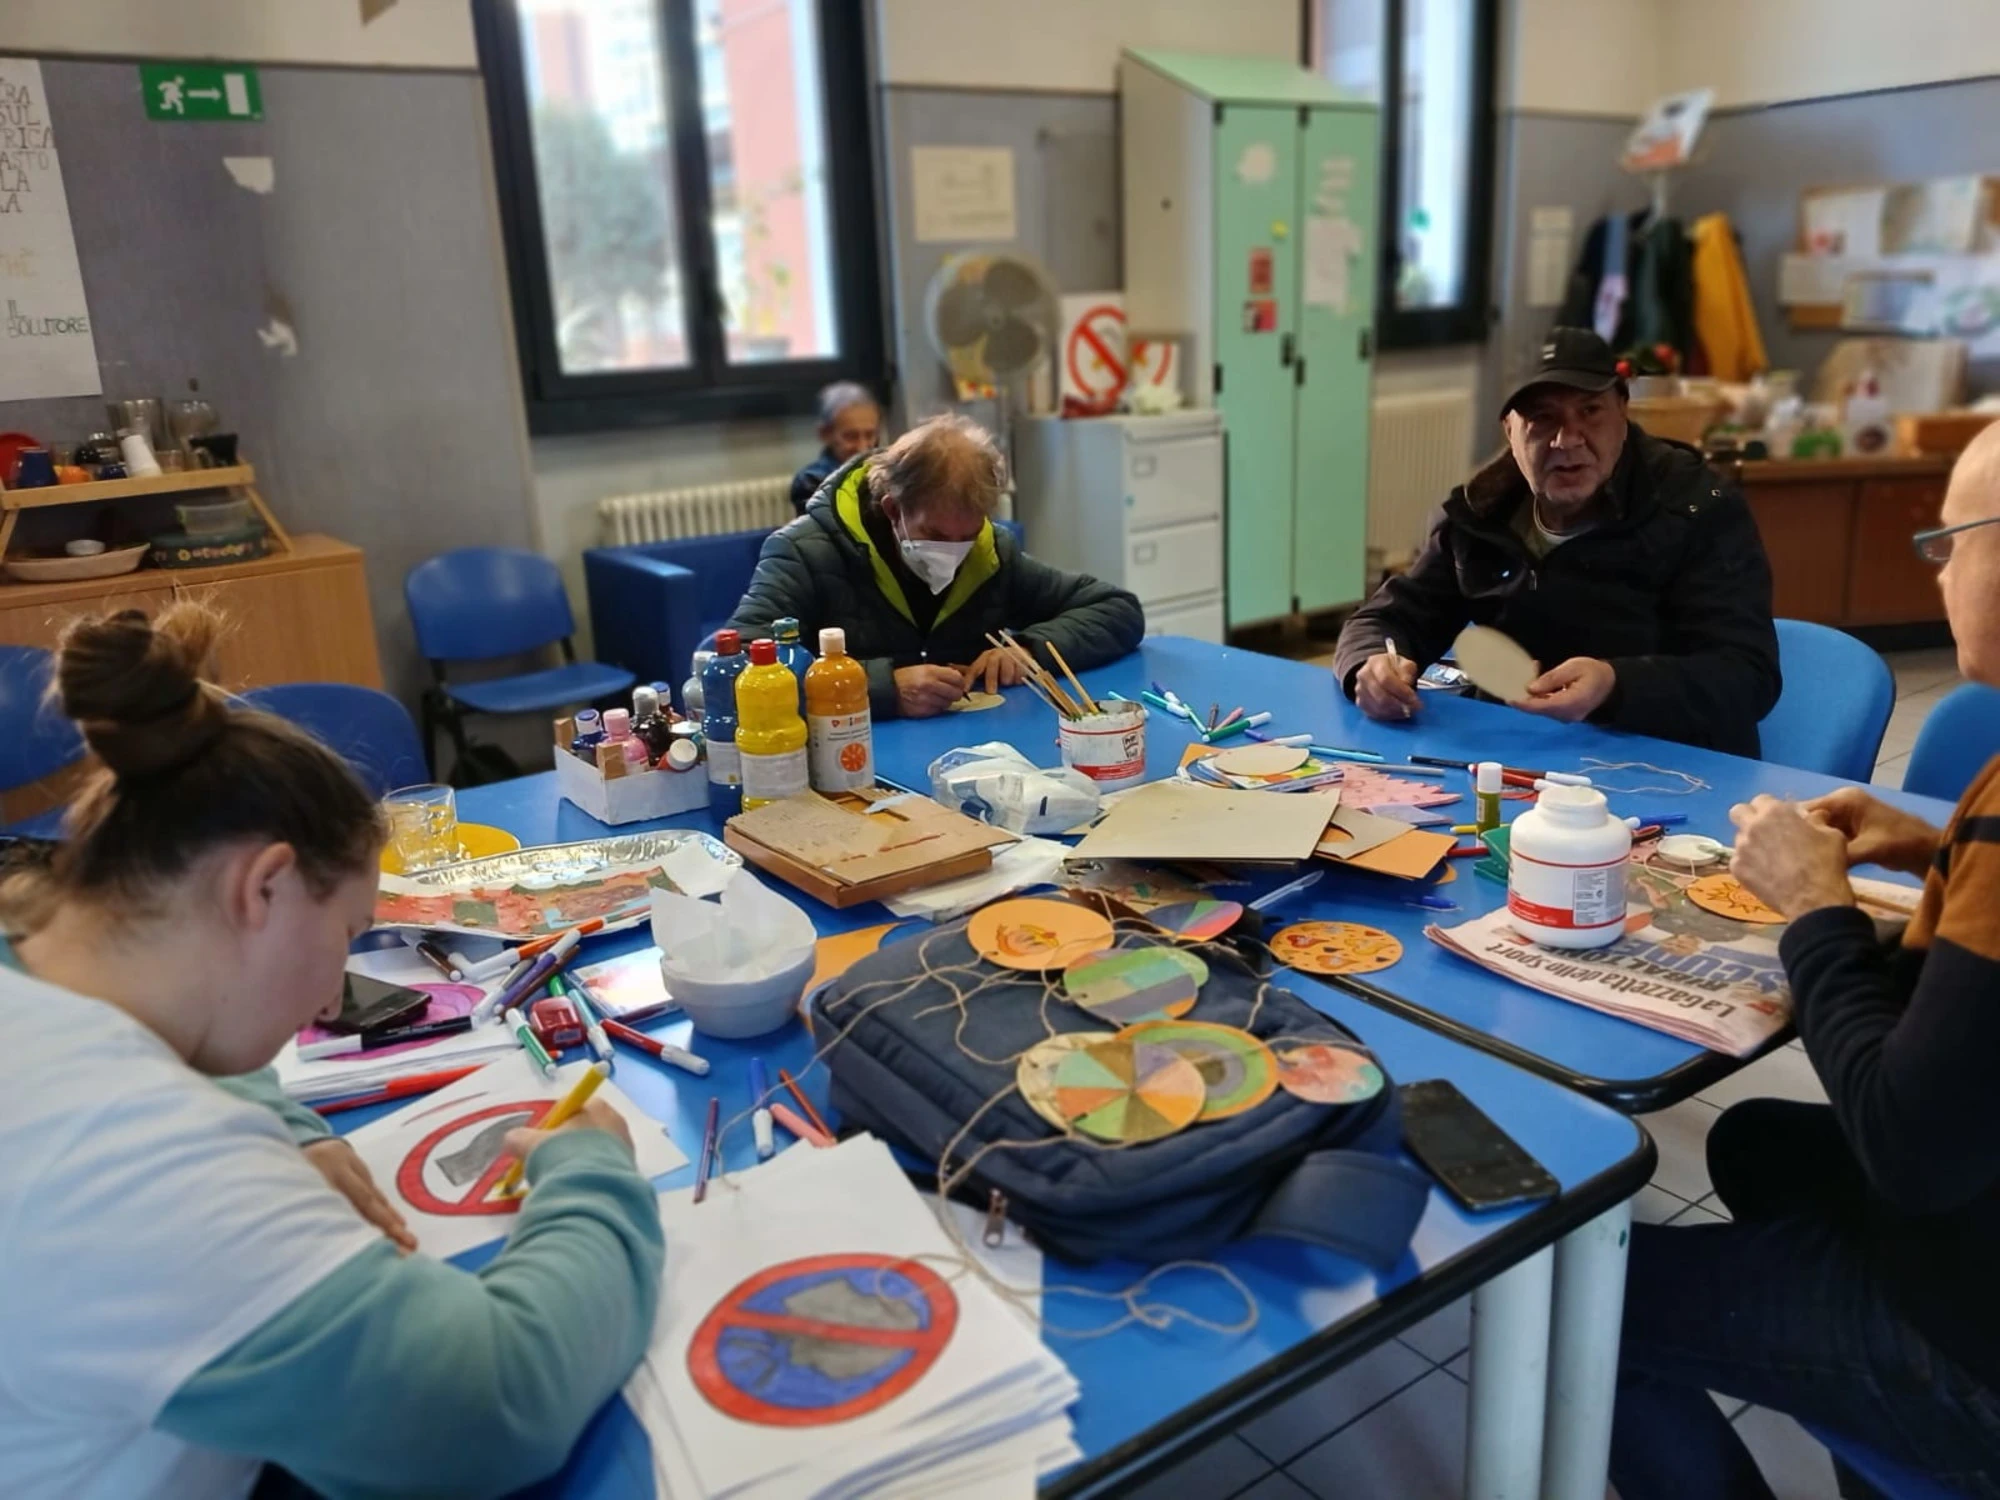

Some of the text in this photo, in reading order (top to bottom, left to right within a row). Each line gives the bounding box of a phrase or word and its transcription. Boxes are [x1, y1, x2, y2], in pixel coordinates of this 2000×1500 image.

[1485, 942, 1737, 1018] La Gazzetta dello Sport
